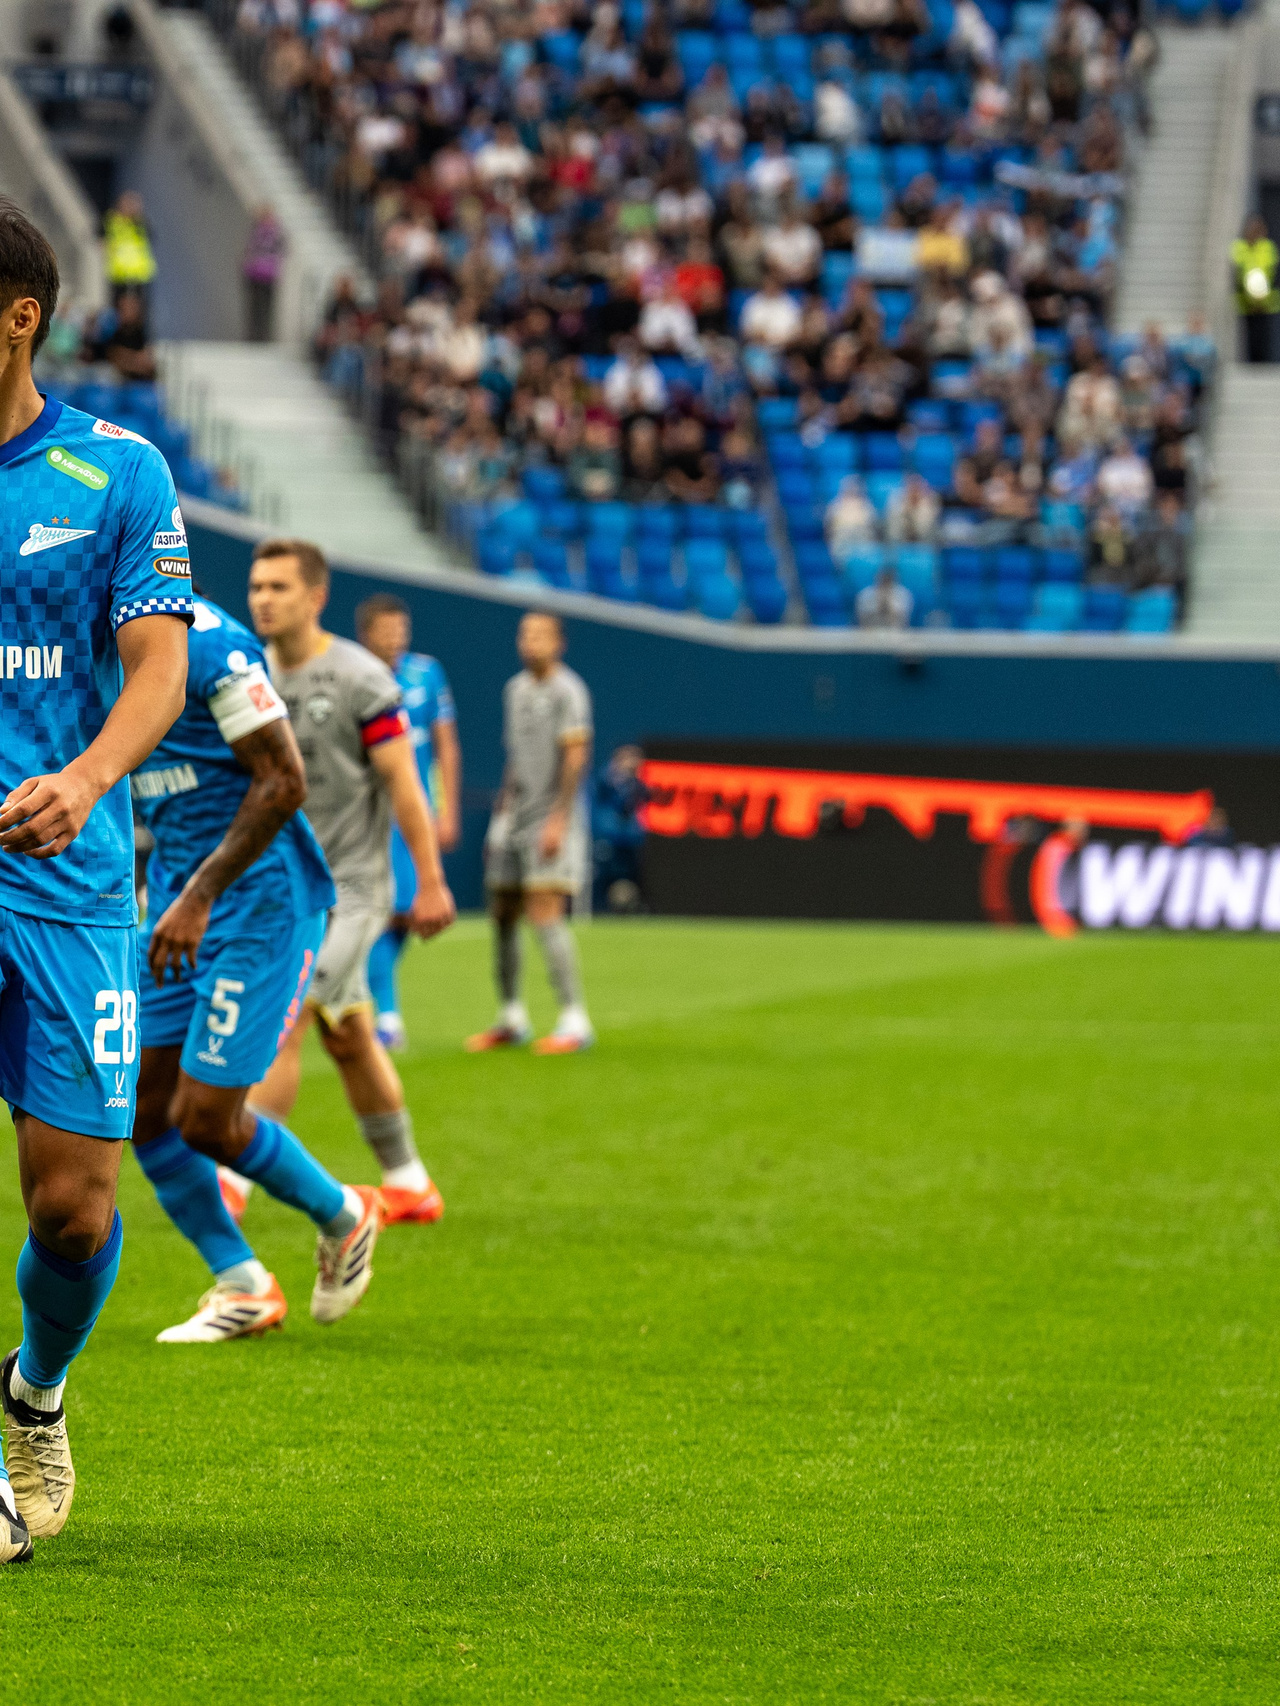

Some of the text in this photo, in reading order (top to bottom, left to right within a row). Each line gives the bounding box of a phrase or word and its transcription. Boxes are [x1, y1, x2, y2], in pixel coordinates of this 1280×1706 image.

[100, 423, 124, 437] SUN
[1078, 841, 1280, 932] WIN
[94, 989, 137, 1065] 28
[207, 977, 245, 1037] 5
